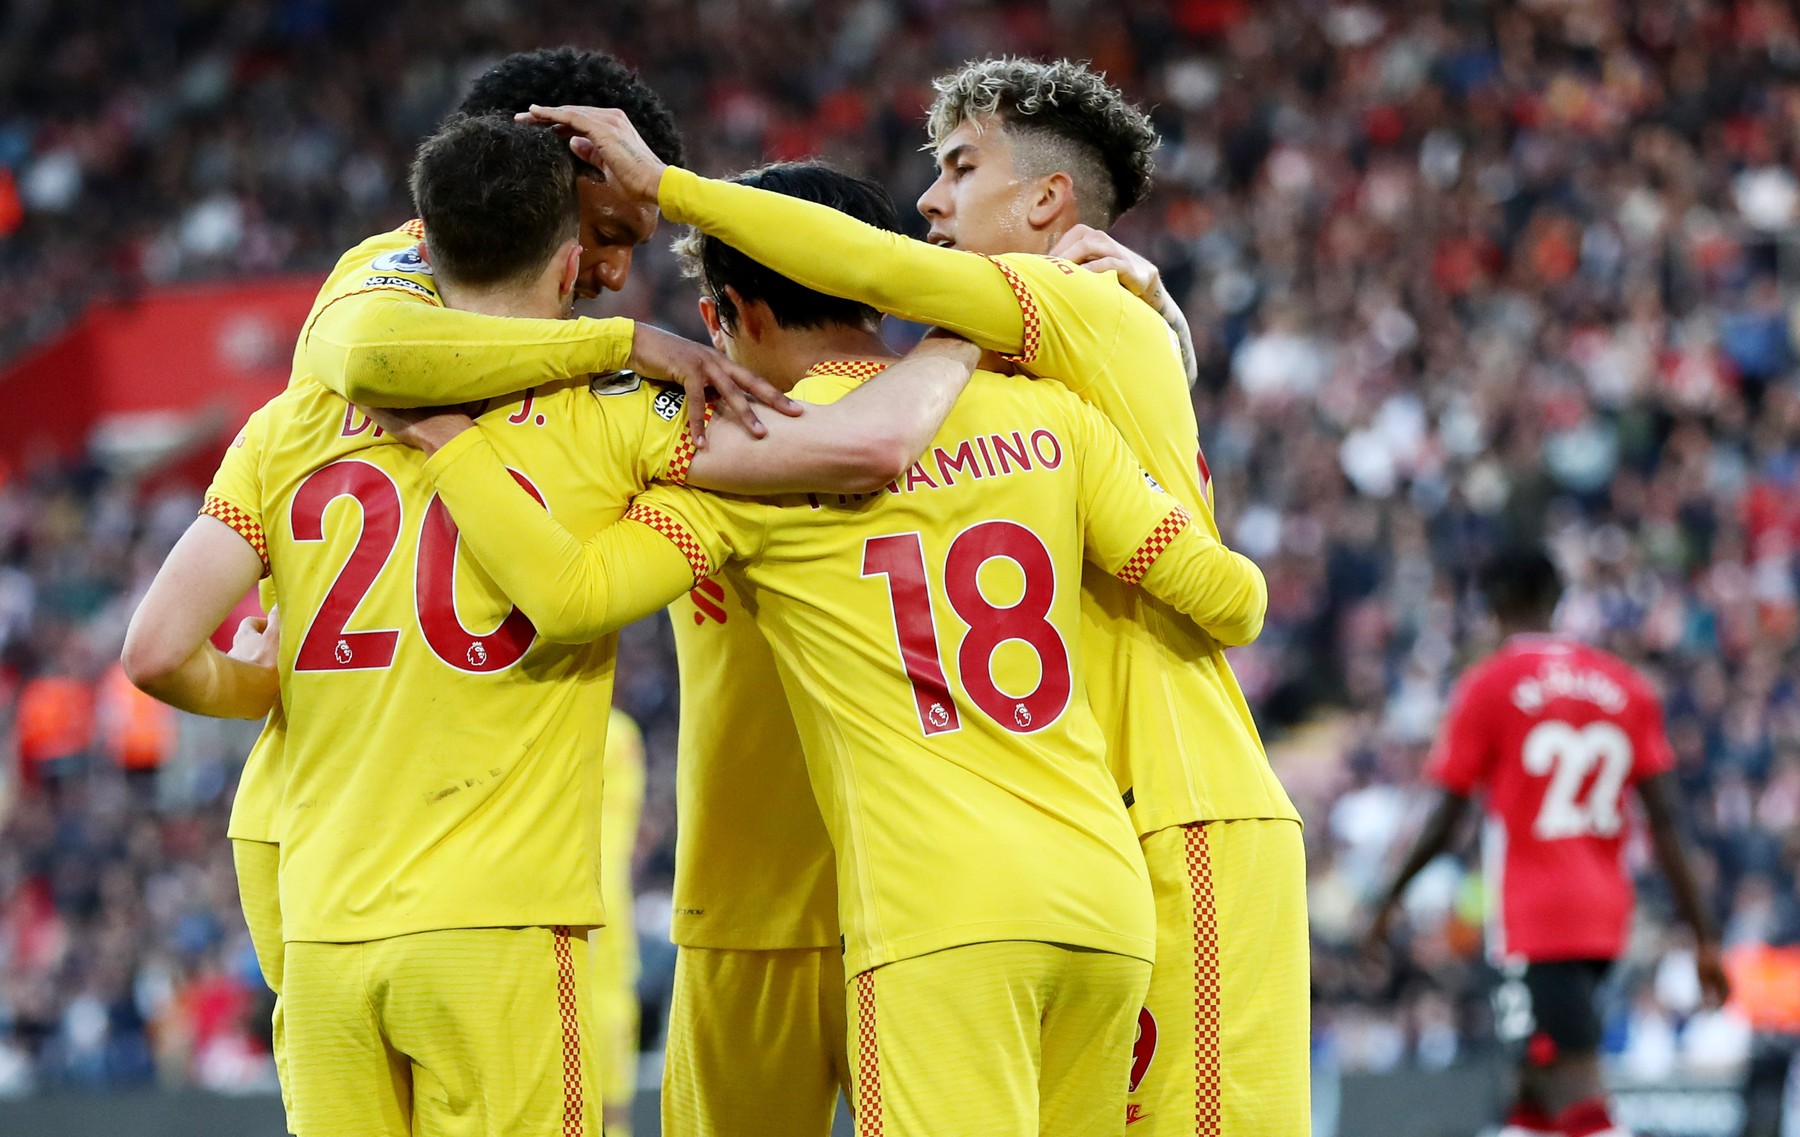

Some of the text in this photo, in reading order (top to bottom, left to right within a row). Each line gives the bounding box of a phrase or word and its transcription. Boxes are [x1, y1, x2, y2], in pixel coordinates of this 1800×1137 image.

[363, 277, 386, 288] No
[508, 388, 546, 426] J.
[807, 427, 1063, 510] AMINO
[289, 459, 550, 675] 20
[861, 519, 1073, 737] 18
[1522, 719, 1634, 841] 22
